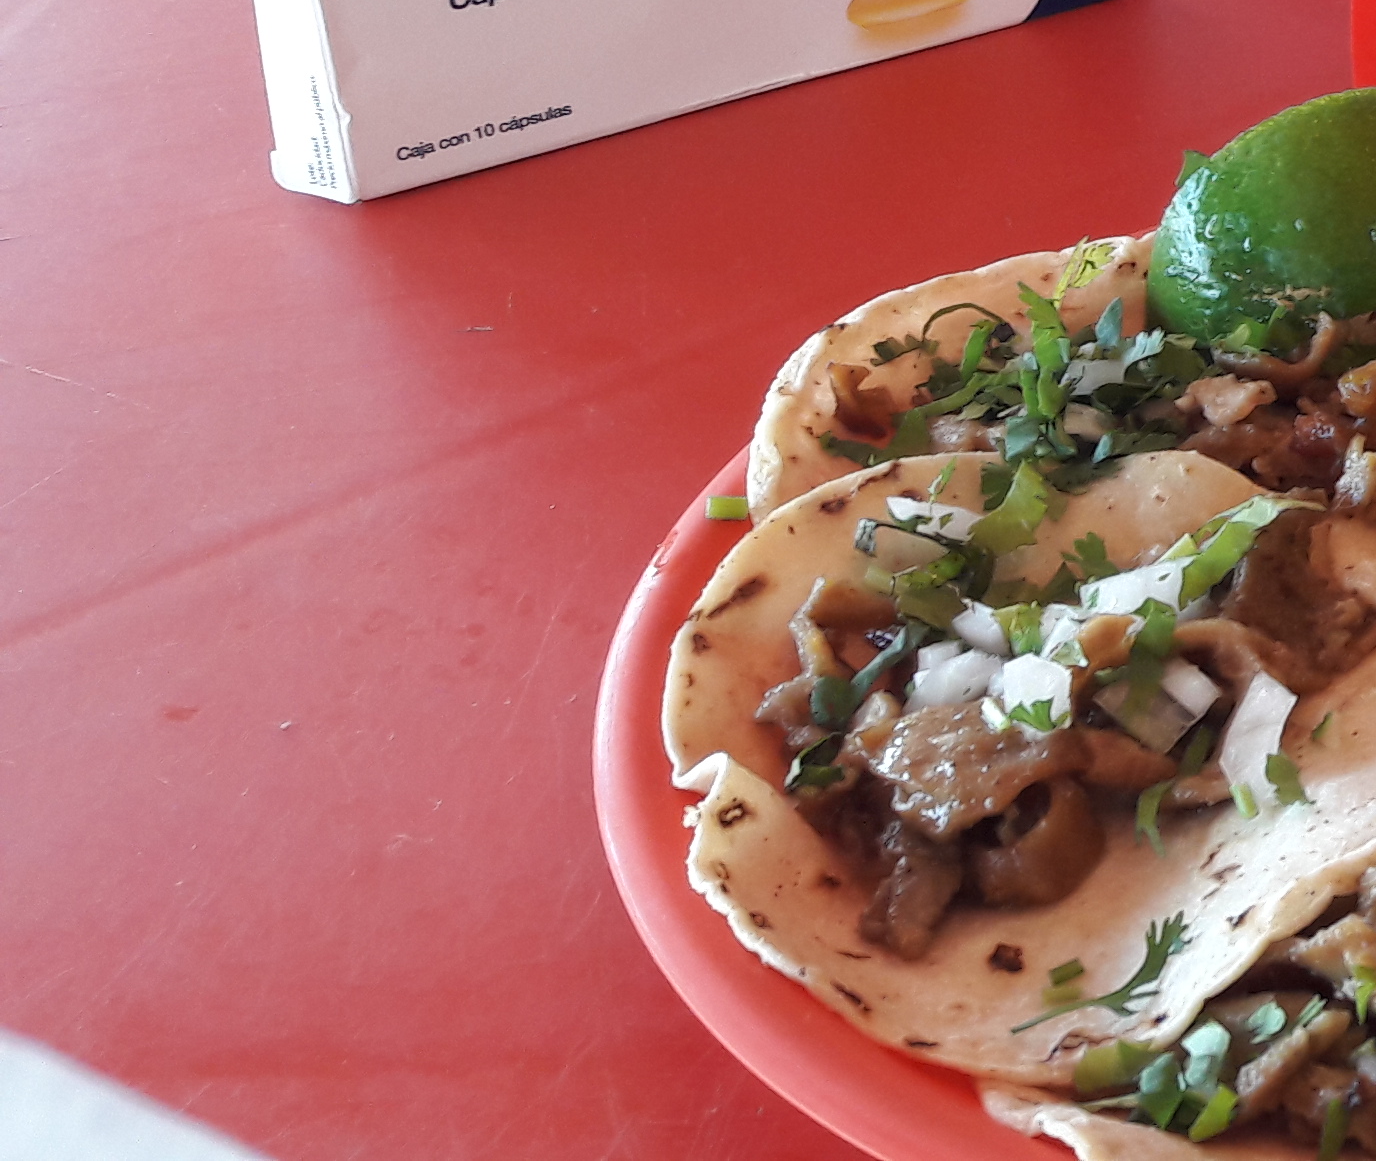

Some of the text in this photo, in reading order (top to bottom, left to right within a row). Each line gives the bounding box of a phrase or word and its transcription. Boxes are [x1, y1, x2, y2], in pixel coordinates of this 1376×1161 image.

[397, 105, 573, 161] Caja con 10 cápsulas
